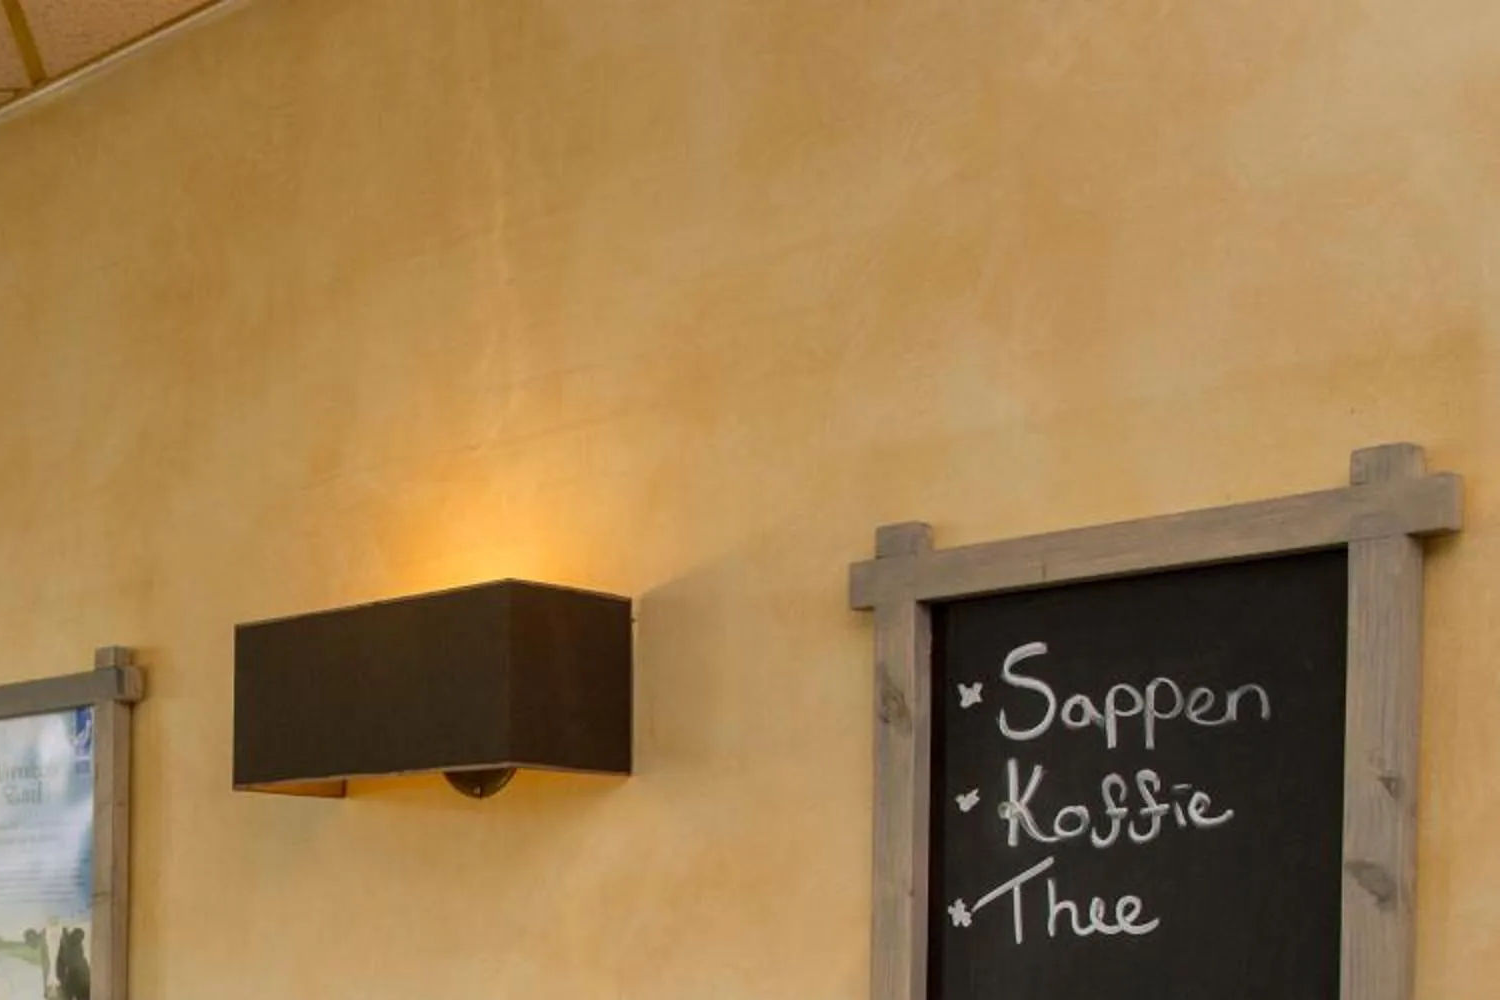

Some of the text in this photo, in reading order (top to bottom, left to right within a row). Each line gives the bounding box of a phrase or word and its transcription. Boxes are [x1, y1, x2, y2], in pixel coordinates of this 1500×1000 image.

[996, 641, 1271, 749] Sappen
[998, 758, 1235, 848] Koffie
[972, 857, 1160, 944] Thee
